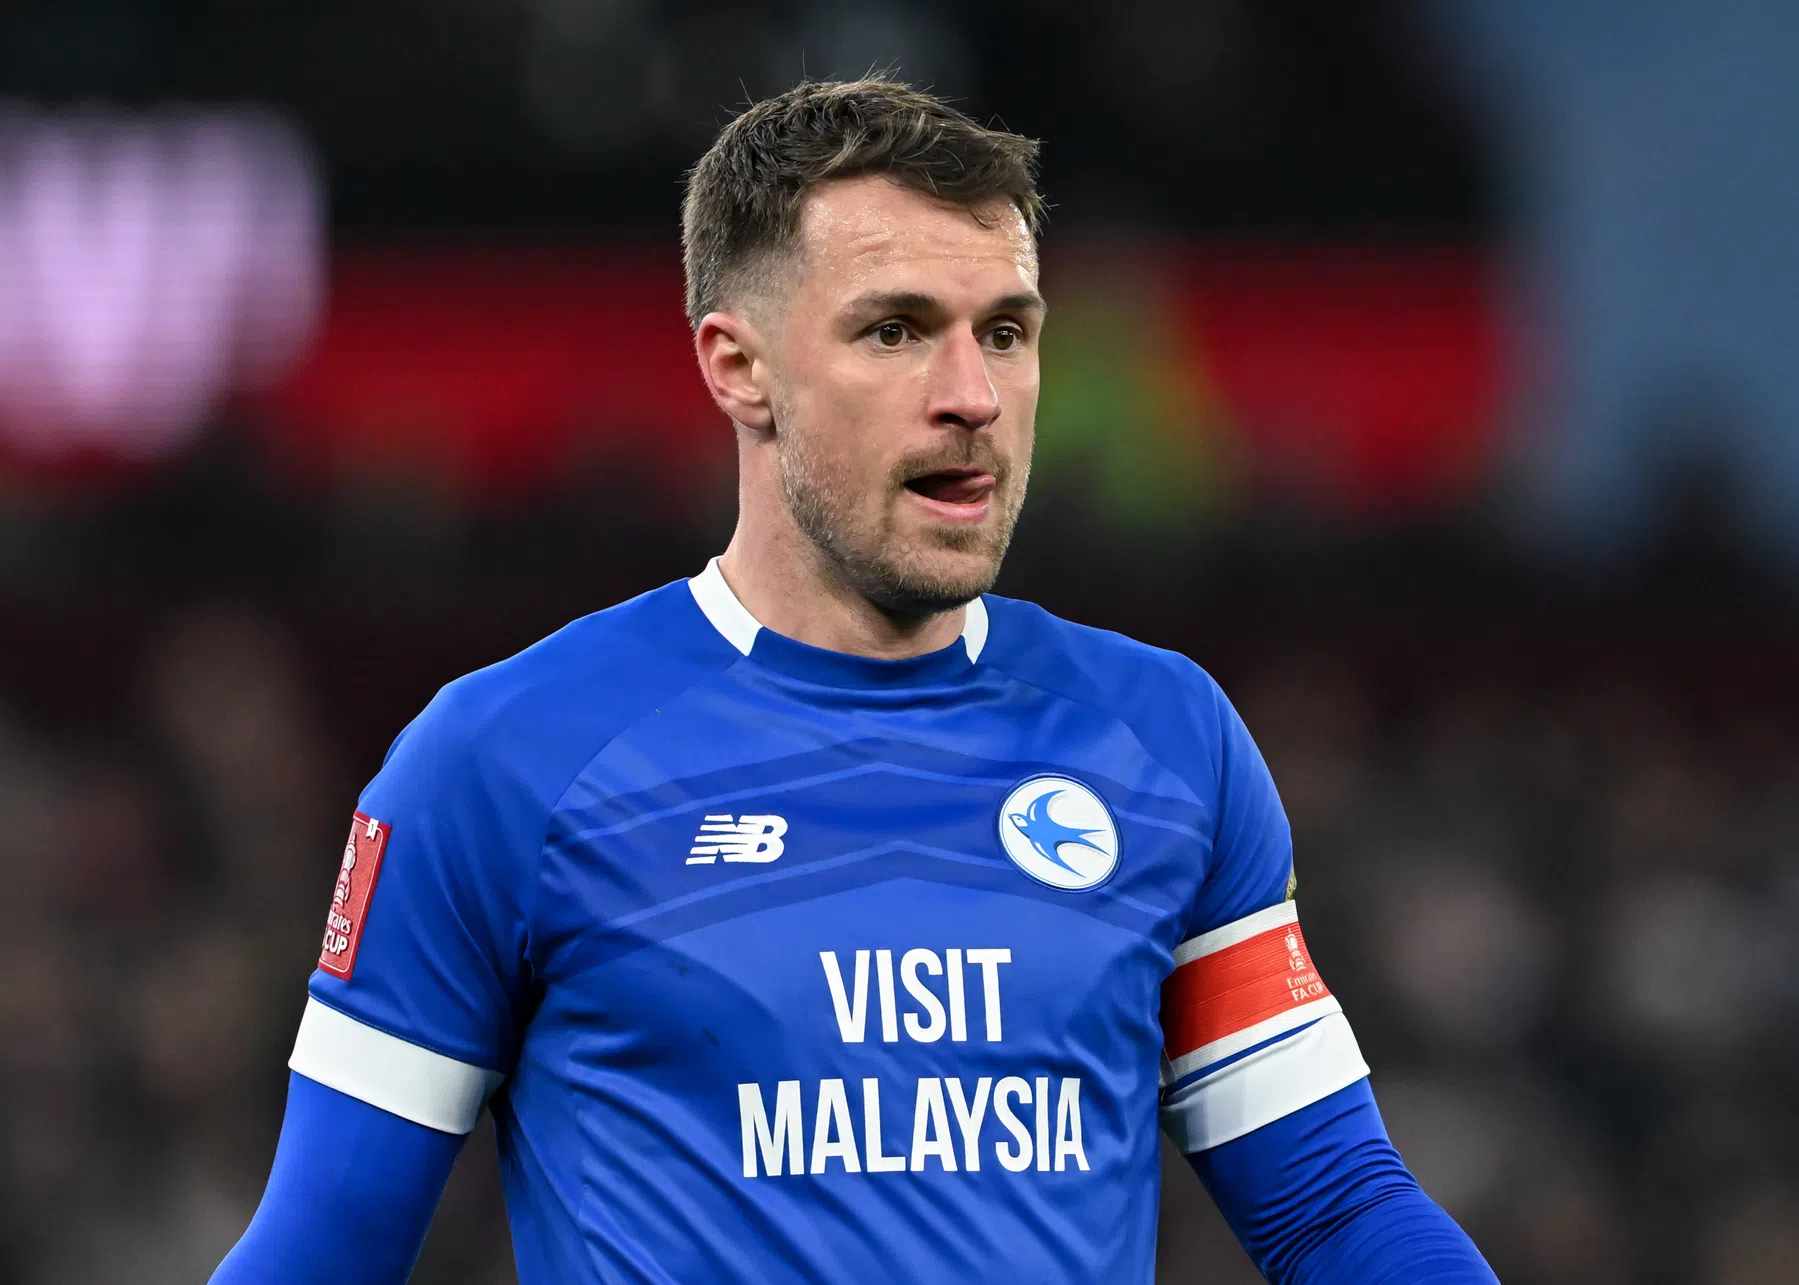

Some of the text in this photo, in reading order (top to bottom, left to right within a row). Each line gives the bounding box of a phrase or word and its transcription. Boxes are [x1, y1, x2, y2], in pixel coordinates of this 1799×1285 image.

[685, 814, 788, 865] NB
[819, 947, 1012, 1043] VISIT
[1291, 981, 1323, 1001] FA CUP
[738, 1076, 1090, 1178] MALAYSIA
